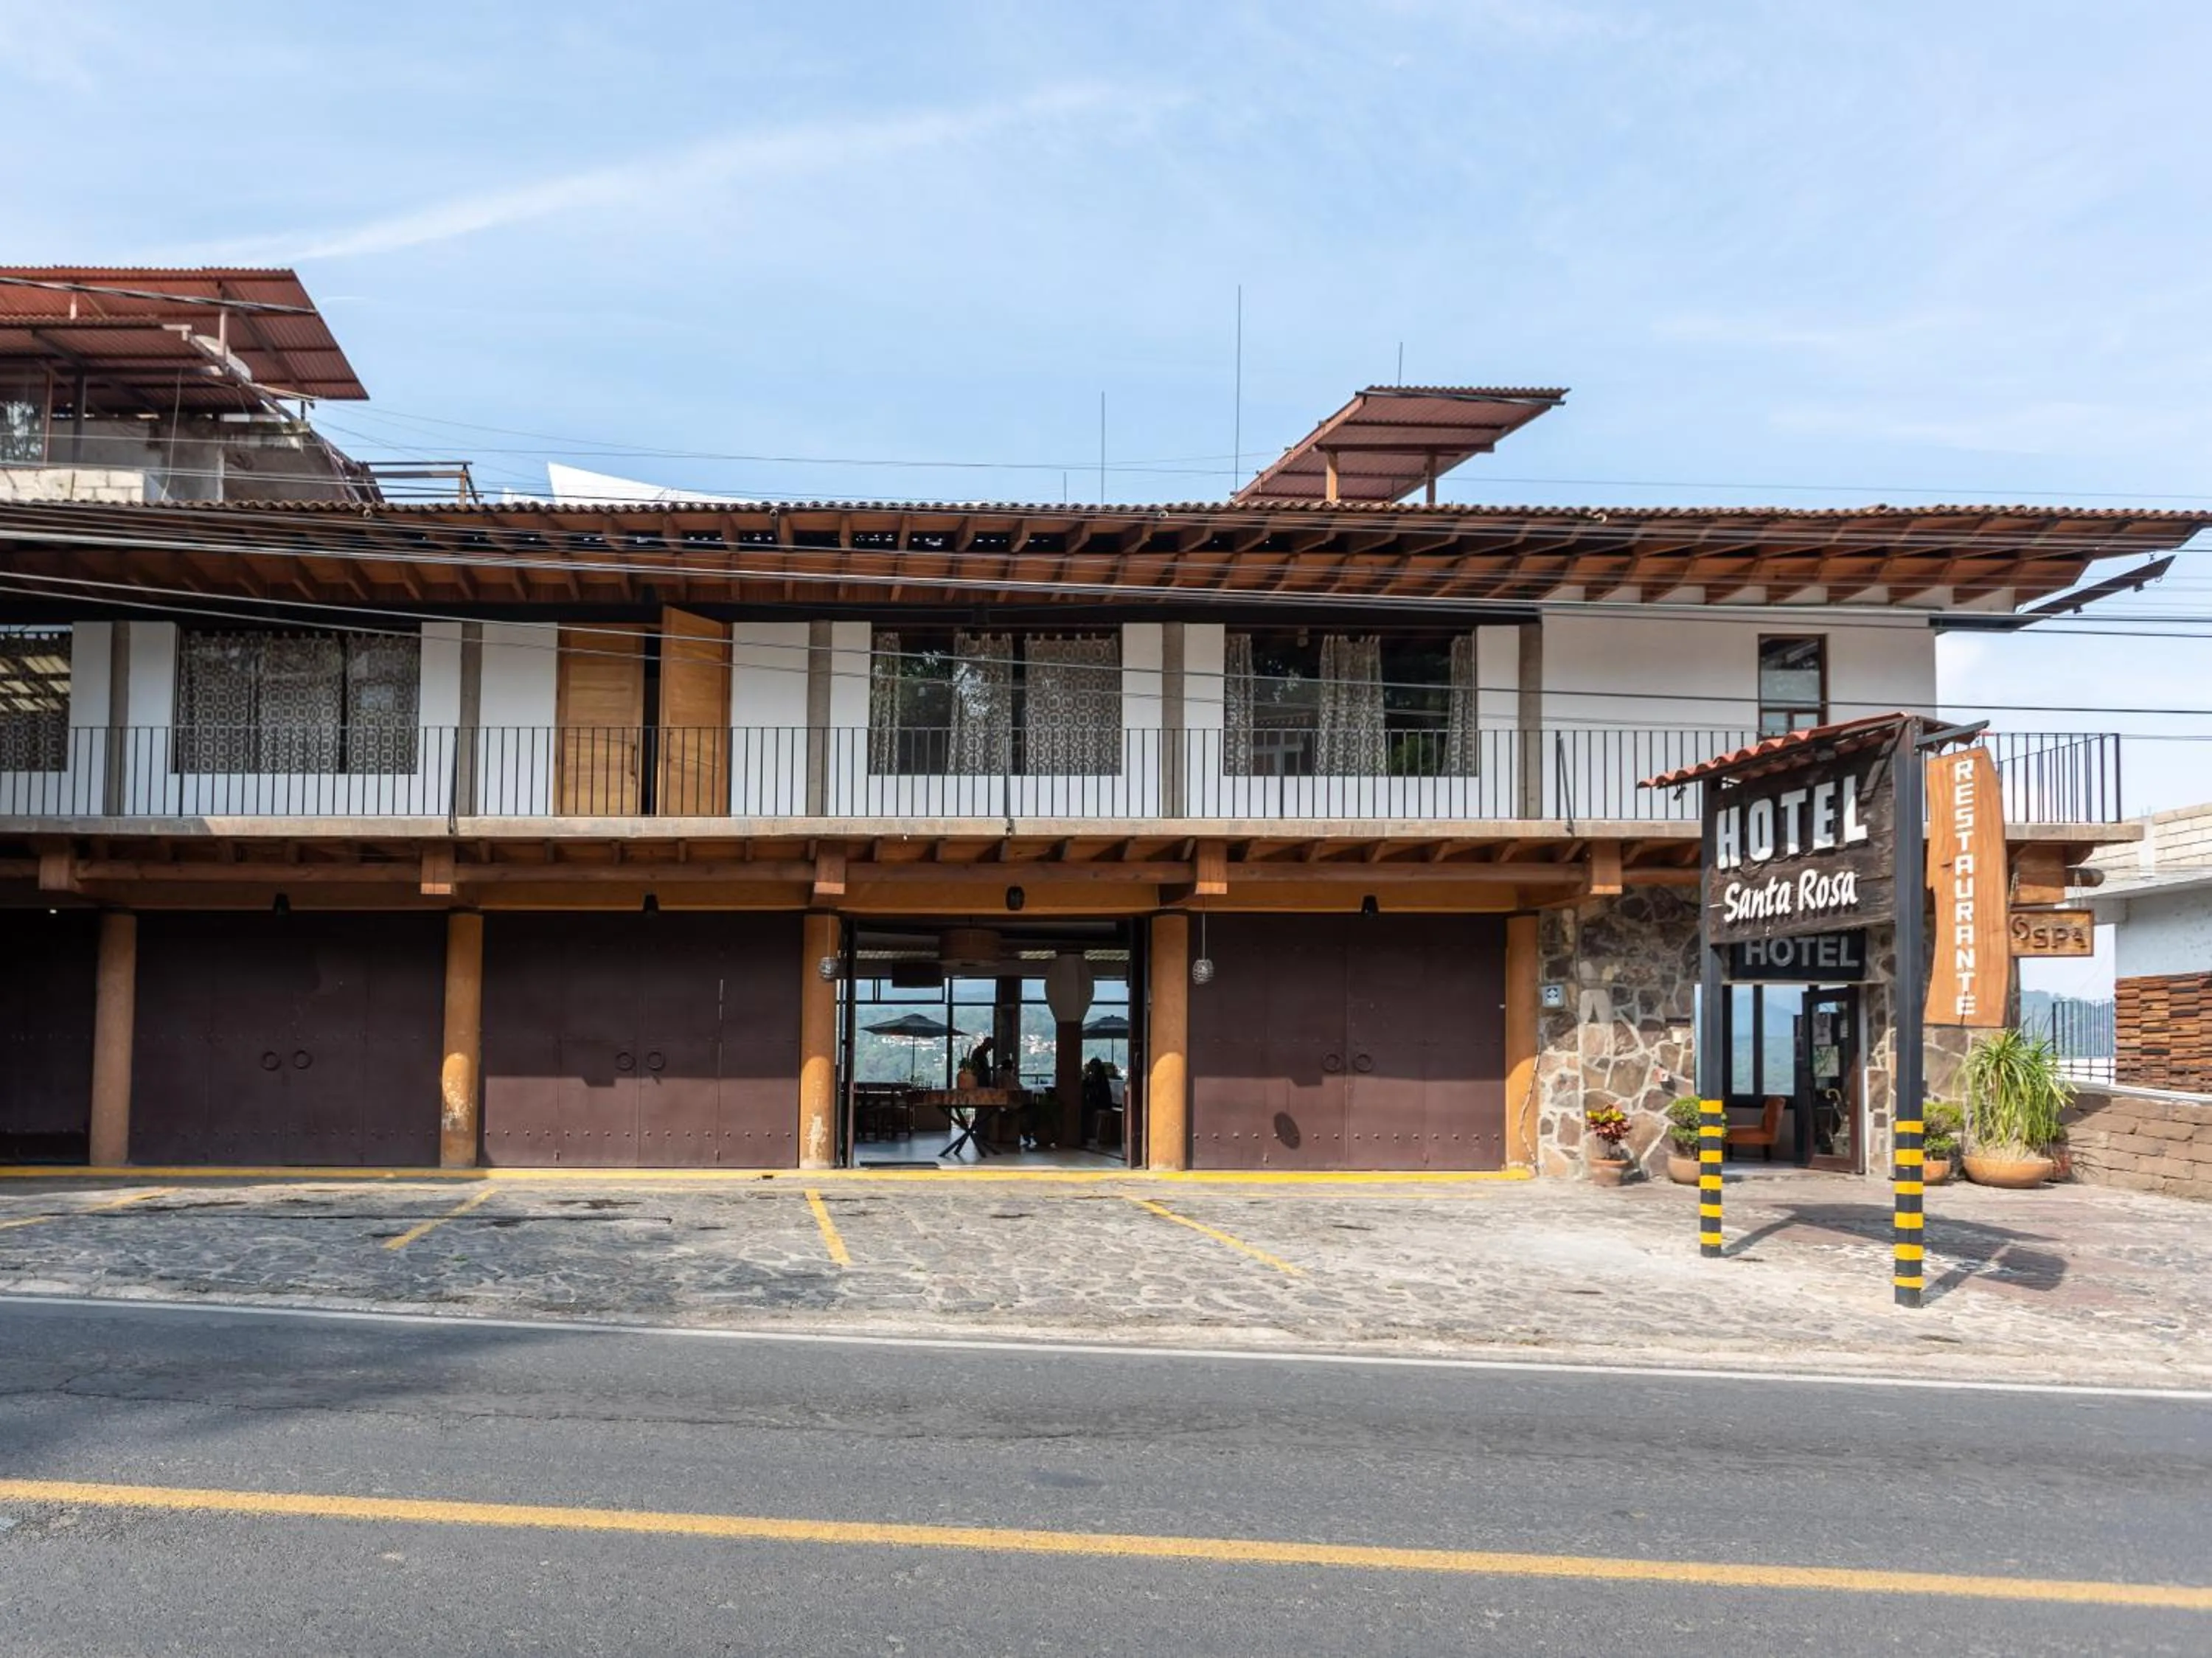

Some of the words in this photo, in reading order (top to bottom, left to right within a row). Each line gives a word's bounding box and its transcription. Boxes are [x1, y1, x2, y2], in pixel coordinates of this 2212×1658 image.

[1717, 774, 1868, 870] HOTEL
[1723, 876, 1792, 923] Santa
[1798, 868, 1859, 912] Rosa
[1955, 759, 1975, 1016] RESTAURANTE
[1745, 935, 1860, 968] HOTEL
[2033, 927, 2087, 949] SPA
